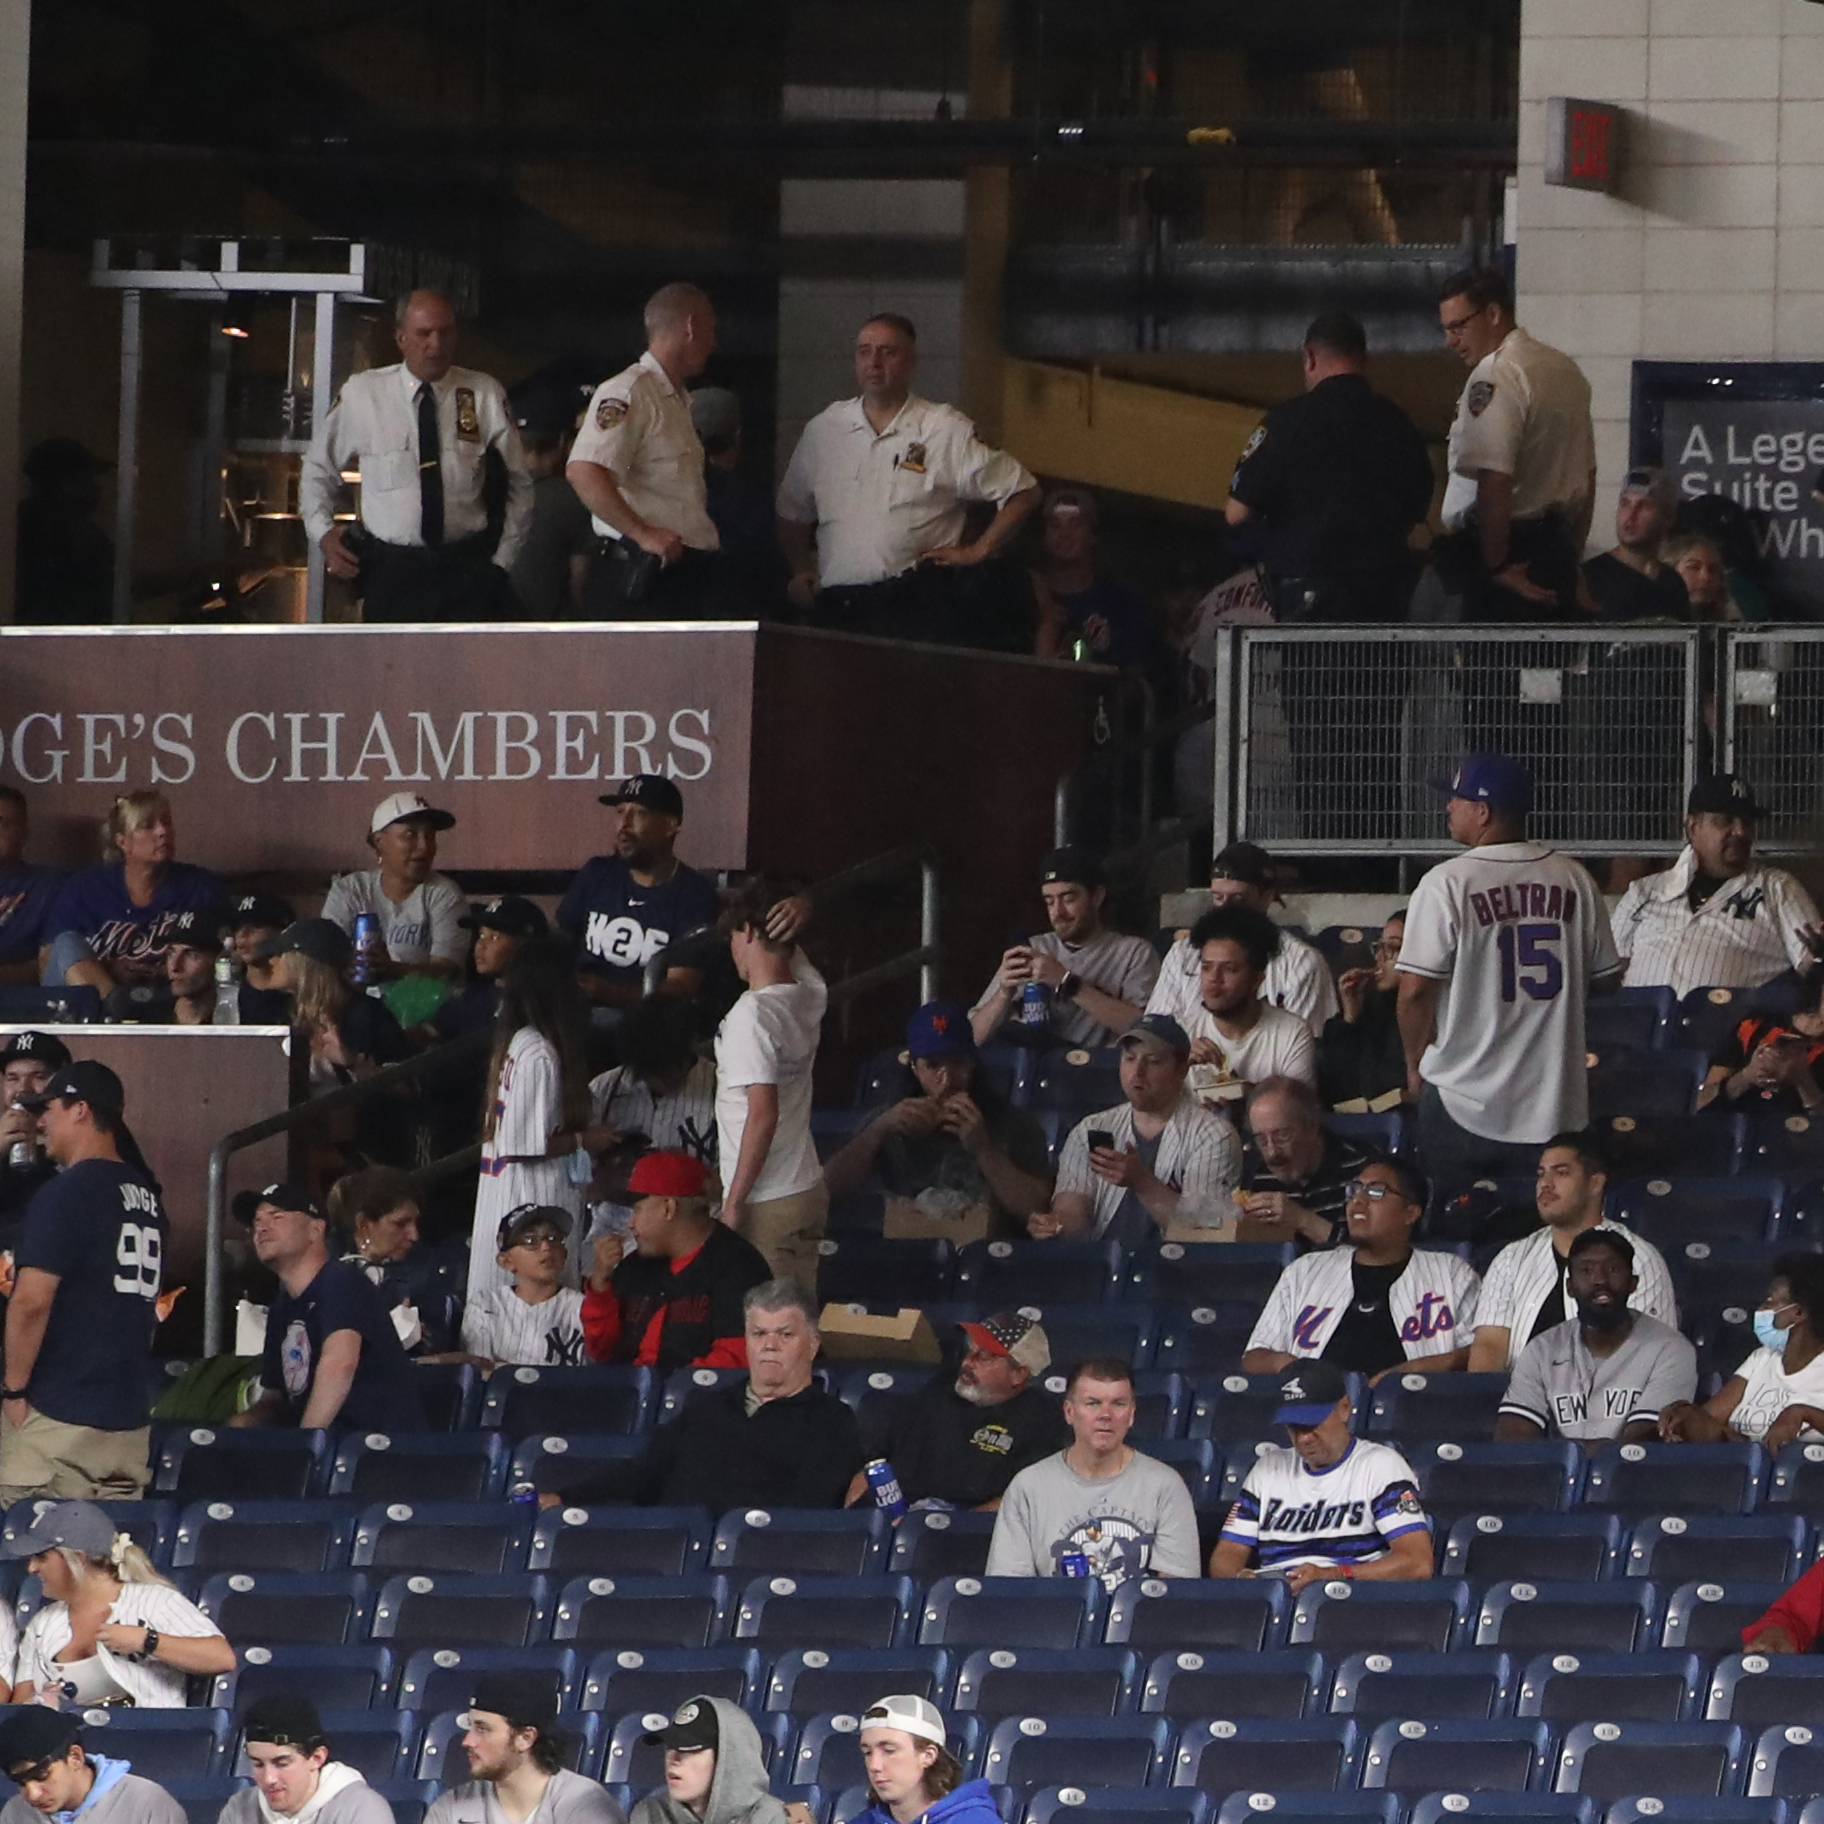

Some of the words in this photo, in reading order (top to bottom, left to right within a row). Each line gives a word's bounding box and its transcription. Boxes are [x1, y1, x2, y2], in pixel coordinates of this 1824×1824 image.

[1680, 424, 1714, 465] A
[0, 712, 197, 784] GE'S
[226, 710, 714, 784] CHAMBERS
[92, 912, 173, 960] Met
[1497, 923, 1563, 1003] 15
[114, 1222, 161, 1300] 99
[875, 1491, 904, 1508] LIGH
[1087, 1503, 1154, 1531] CAPTAIN
[1259, 1498, 1365, 1535] Raiders
